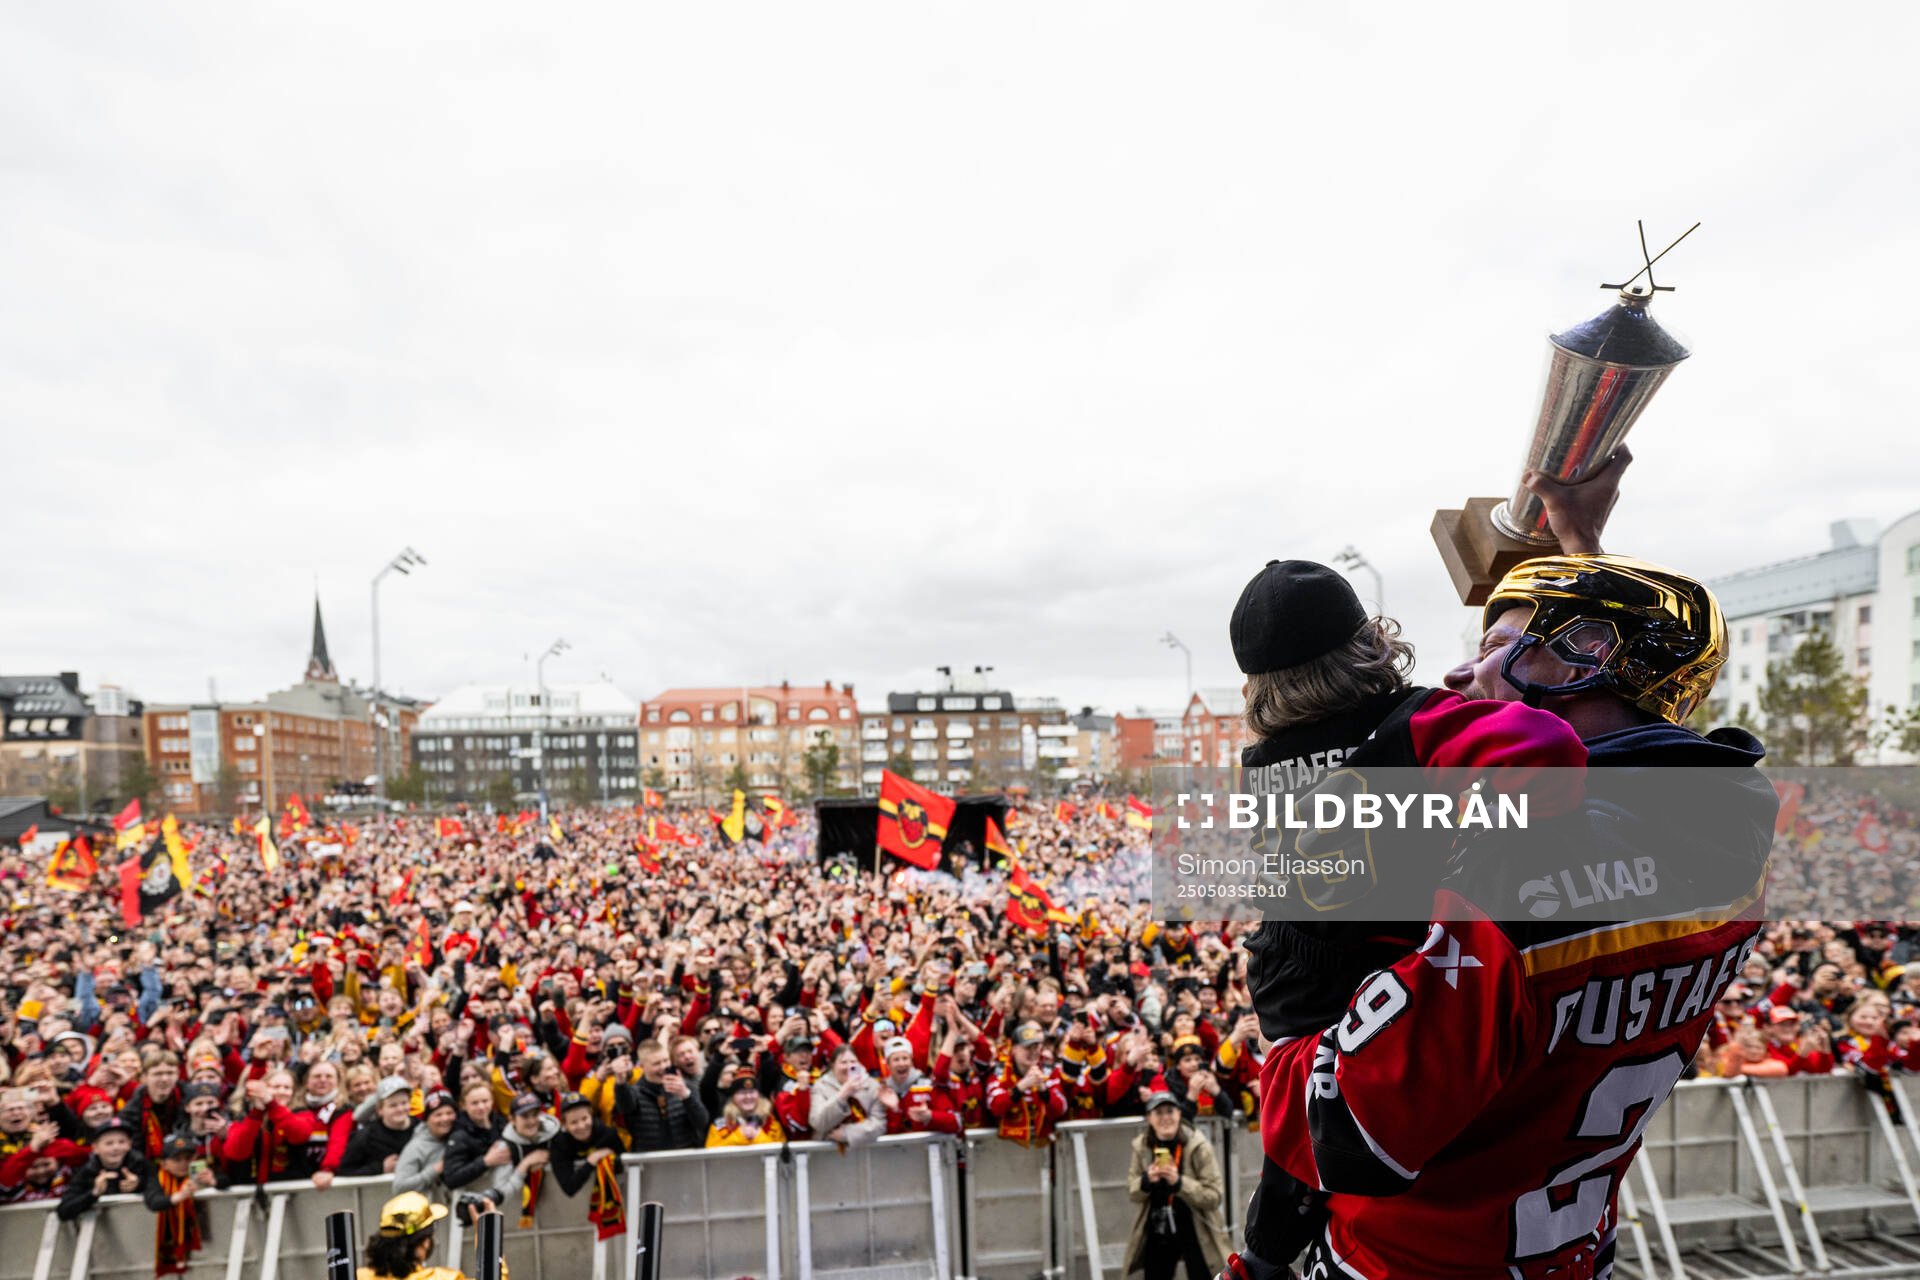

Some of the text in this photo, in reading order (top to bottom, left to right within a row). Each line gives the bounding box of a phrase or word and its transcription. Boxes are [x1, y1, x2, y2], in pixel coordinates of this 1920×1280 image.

[1249, 747, 1359, 798] GUSTAFS
[1559, 856, 1659, 909] LKAB
[1337, 968, 1413, 1056] 9
[1514, 1050, 1685, 1259] 2
